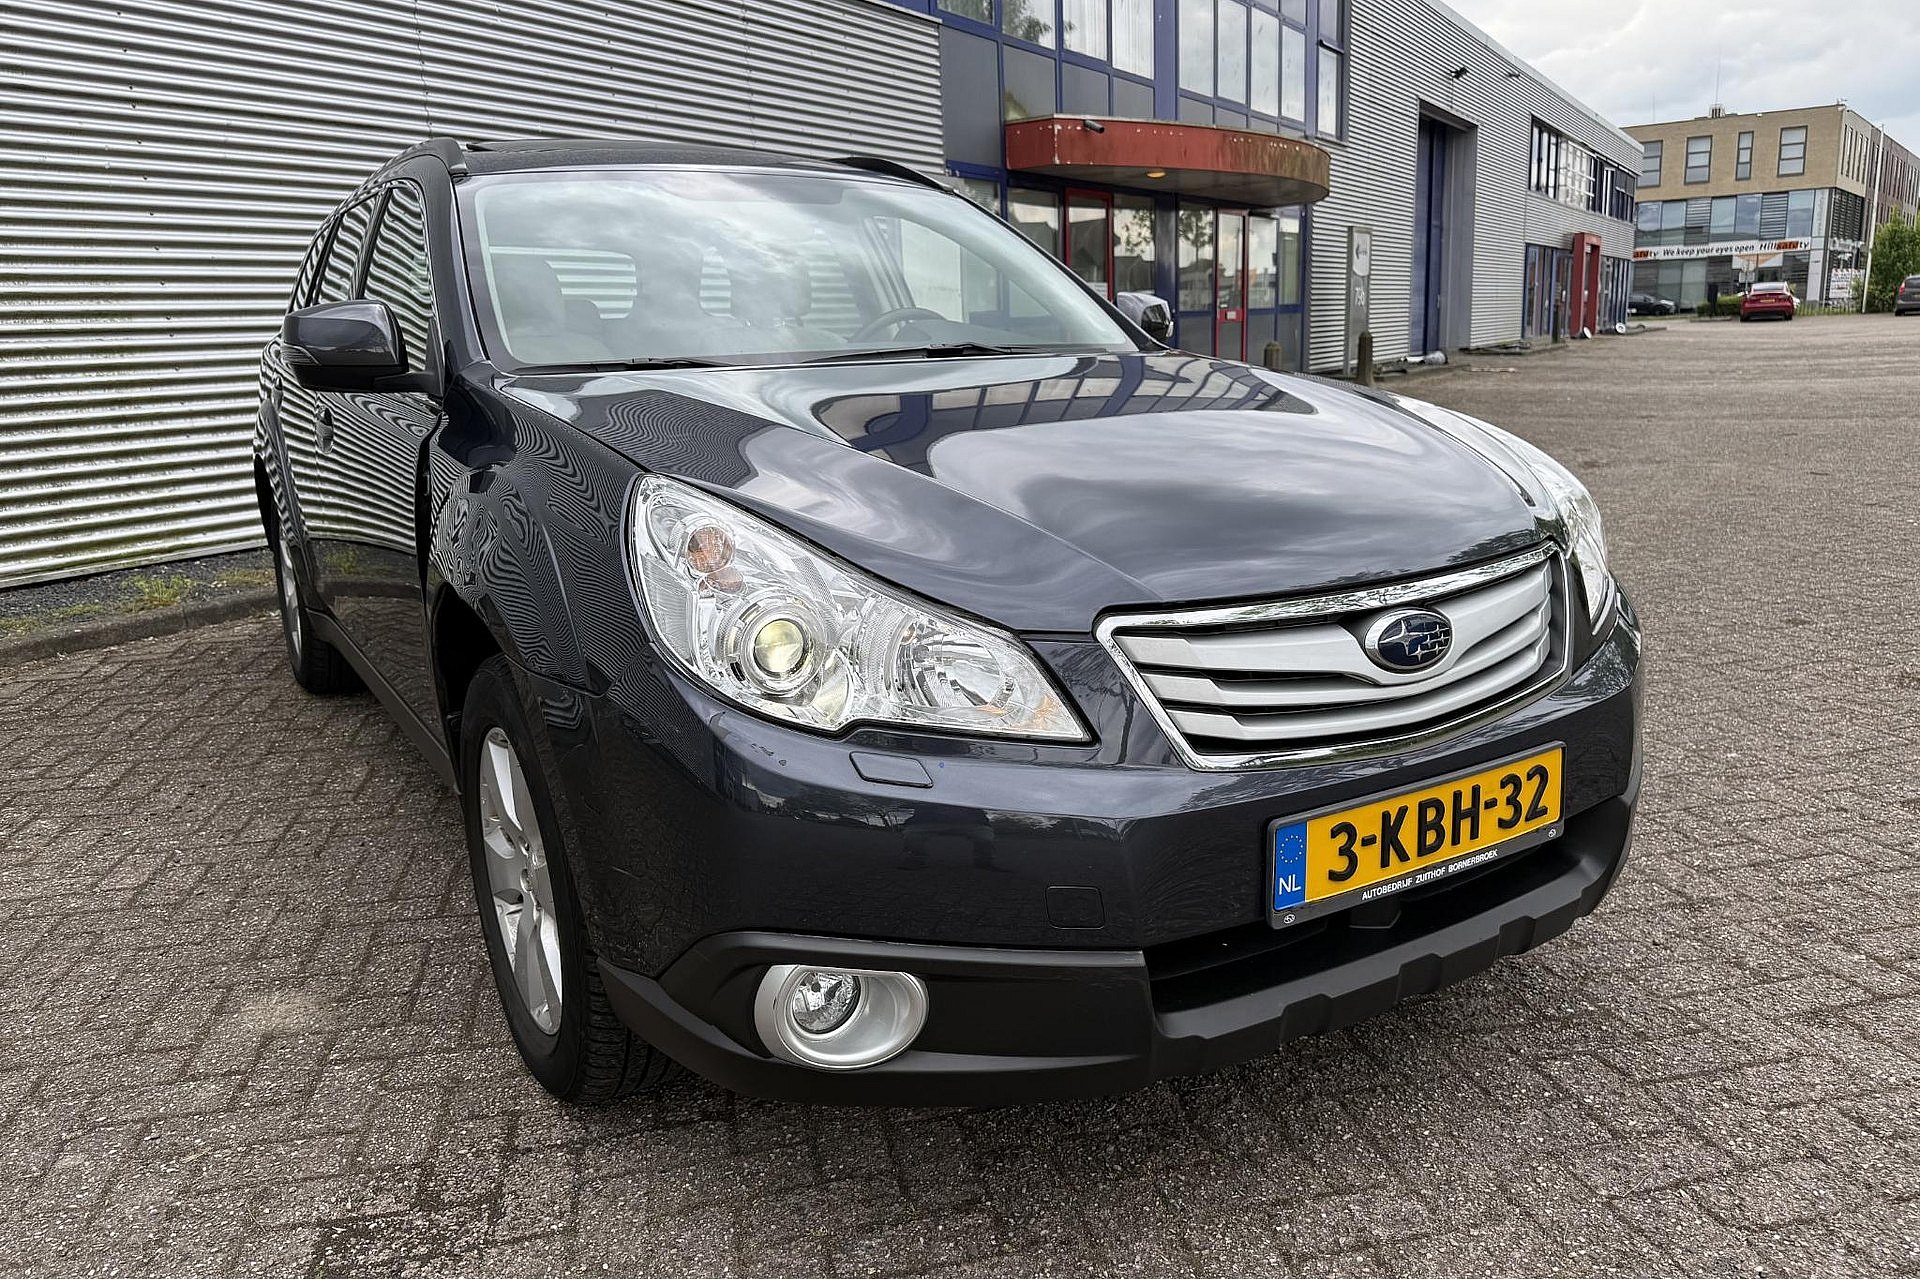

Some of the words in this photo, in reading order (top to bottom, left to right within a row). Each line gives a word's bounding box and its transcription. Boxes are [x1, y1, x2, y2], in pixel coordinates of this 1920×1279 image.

[1663, 248, 1674, 256] We
[1675, 248, 1695, 257] keep
[1696, 247, 1714, 256] your
[1715, 246, 1733, 255] eyes
[1735, 245, 1755, 254] open
[1328, 764, 1549, 882] 3-KBH-32
[1279, 874, 1301, 895] NL
[1361, 877, 1413, 900] AUTOBEDRIJF
[1415, 867, 1446, 884] ZUITHOF
[1448, 849, 1499, 873] BORNERBROEK
